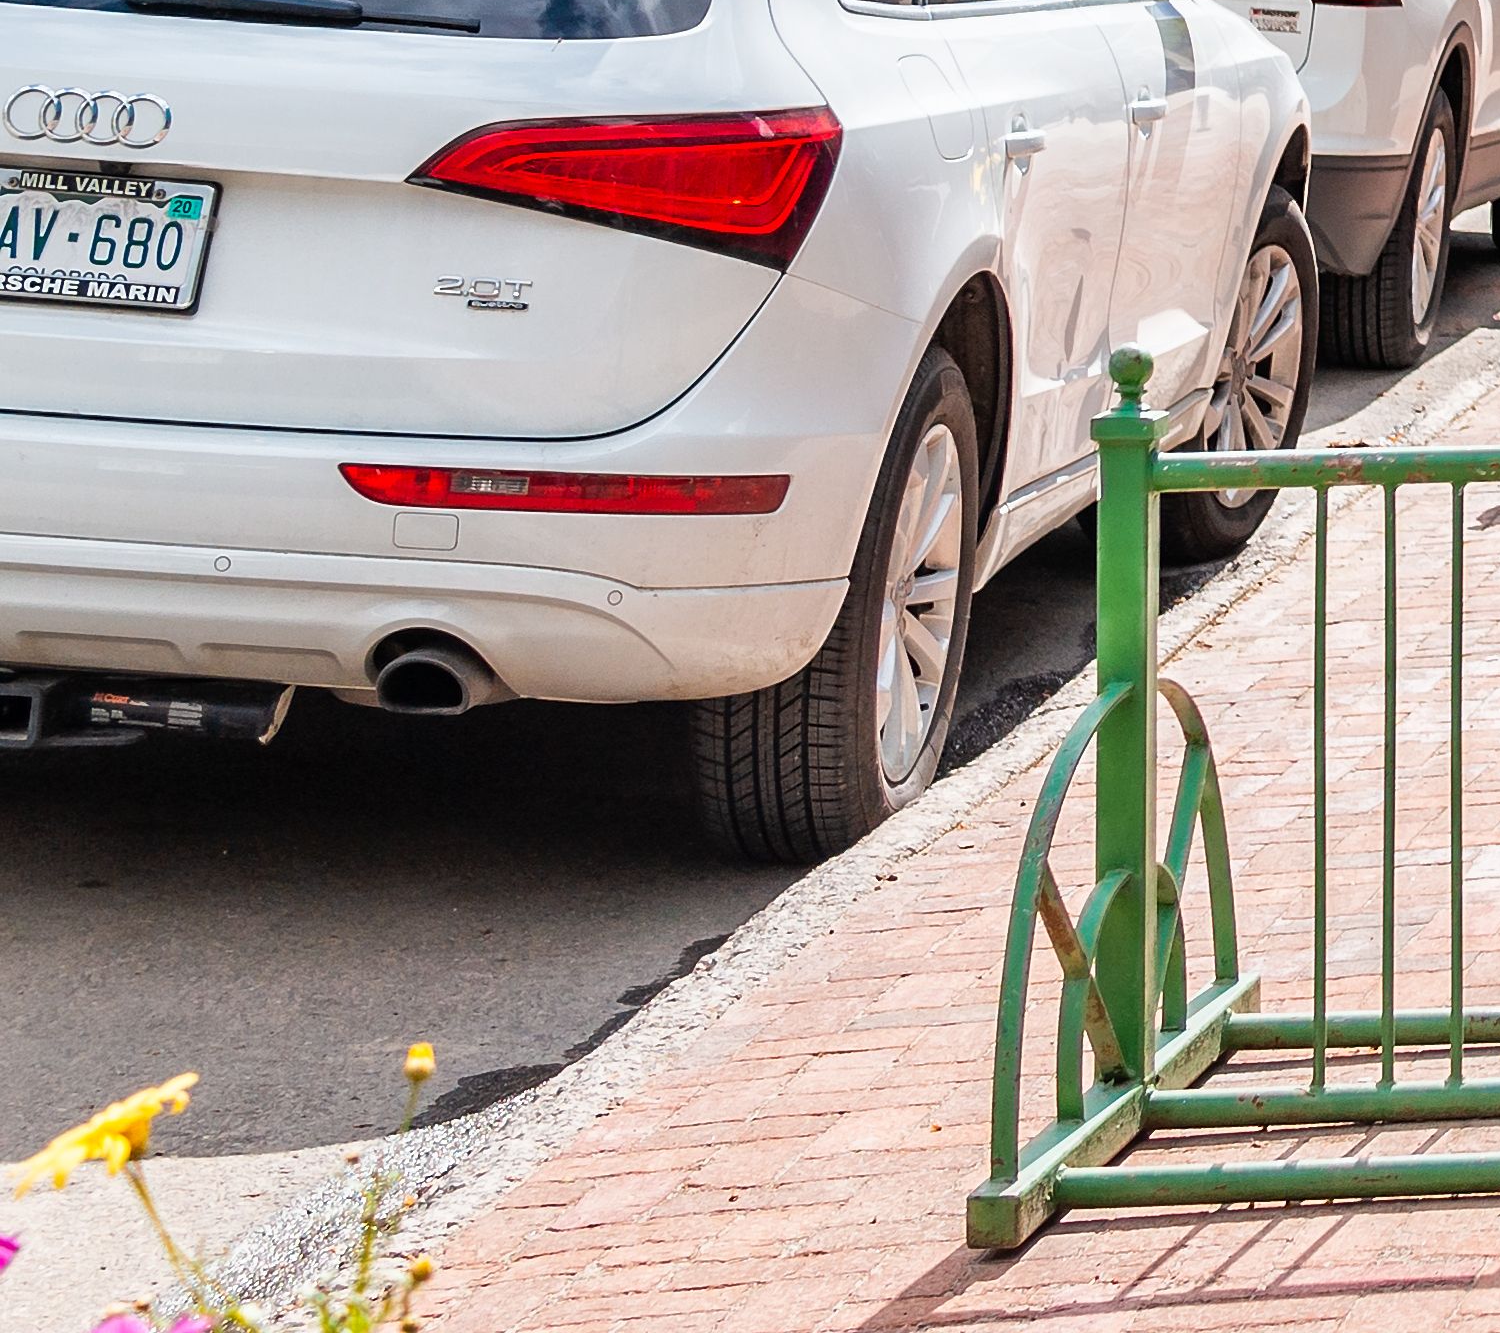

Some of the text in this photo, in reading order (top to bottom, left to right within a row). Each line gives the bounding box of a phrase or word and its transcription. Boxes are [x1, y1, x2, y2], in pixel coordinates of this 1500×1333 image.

[21, 172, 152, 197] MILL VALLEY
[172, 199, 193, 215] 20
[86, 280, 177, 304] MARIN
[433, 276, 533, 299] 2.0T
